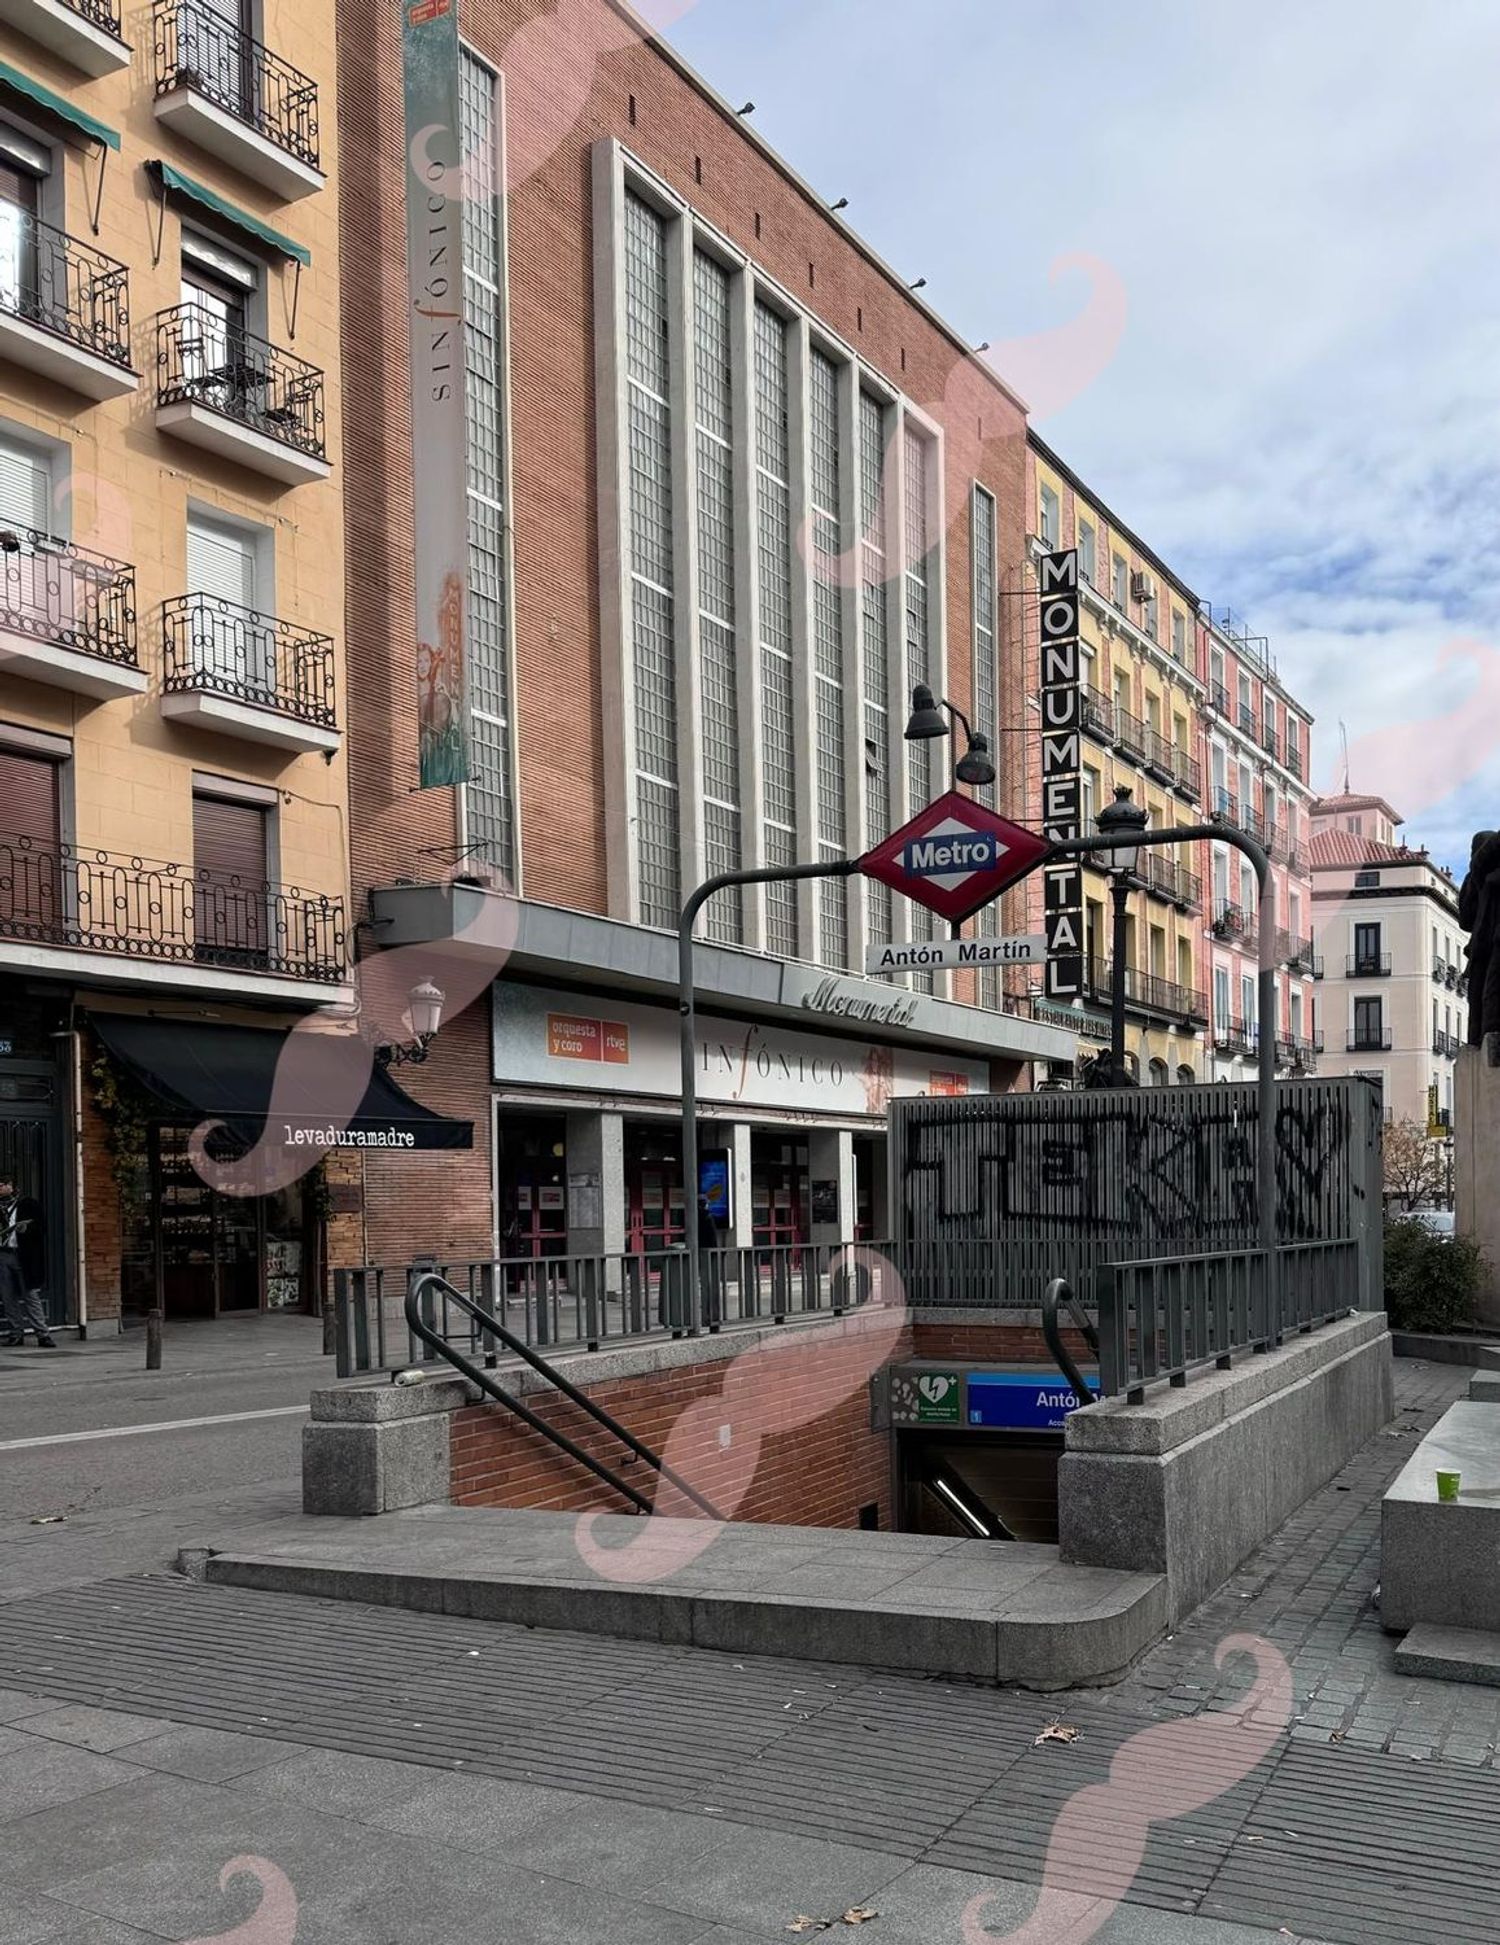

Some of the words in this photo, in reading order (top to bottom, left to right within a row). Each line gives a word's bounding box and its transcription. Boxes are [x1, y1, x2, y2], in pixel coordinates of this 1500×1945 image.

[911, 841, 990, 869] Metro
[880, 946, 944, 967] Antón
[958, 941, 1031, 962] Martín
[552, 1021, 597, 1038] orquesta
[553, 1038, 561, 1053] y
[561, 1040, 583, 1053] coro
[606, 1034, 626, 1052] rtve
[284, 1125, 415, 1148] levaduramadre
